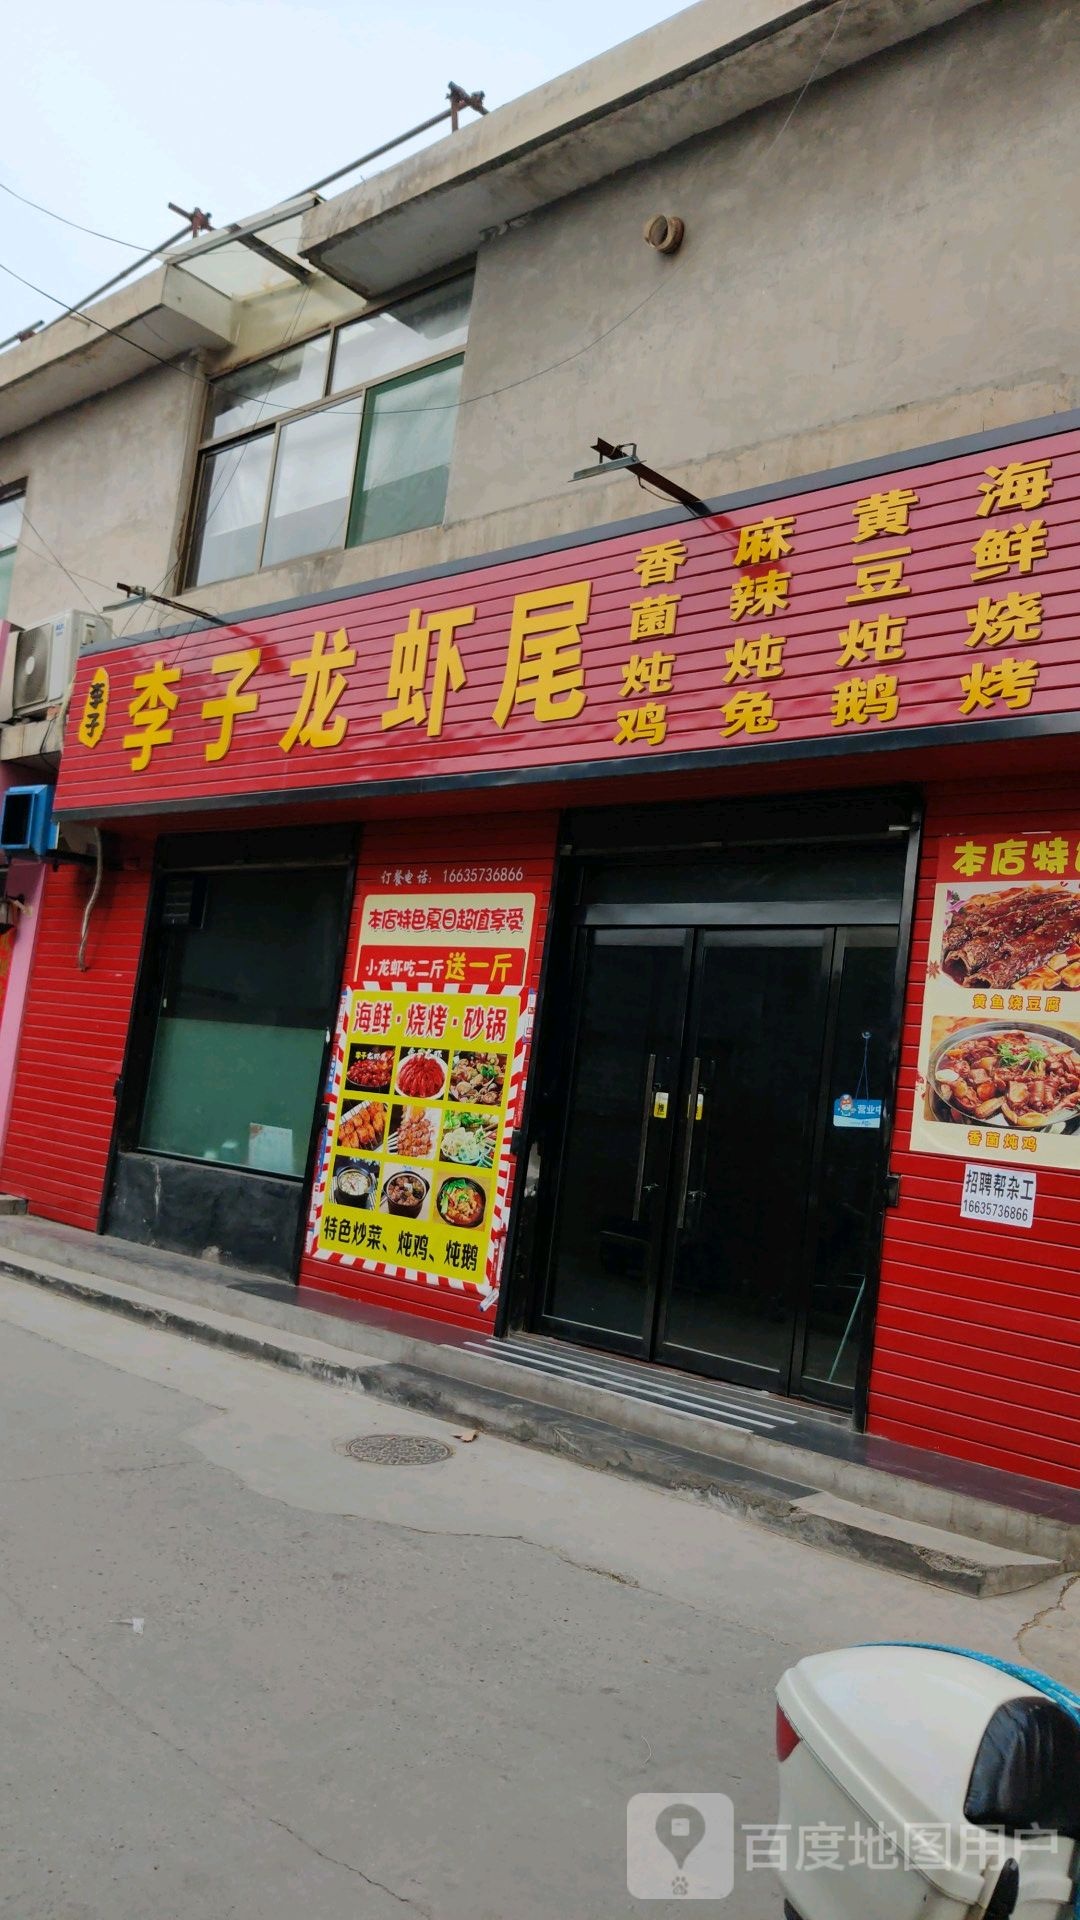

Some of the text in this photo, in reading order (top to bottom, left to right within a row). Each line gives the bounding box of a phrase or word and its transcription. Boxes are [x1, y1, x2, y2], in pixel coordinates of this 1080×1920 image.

[958, 459, 1054, 714] 海鲜烧烤
[720, 516, 795, 737] 麻辣炖兔
[831, 489, 919, 726] 黄豆炖鹅
[613, 539, 687, 745] 香菌炖鸡
[123, 580, 592, 771] 李子龙虾尾
[85, 683, 105, 737] 李子
[443, 867, 523, 883] 16635736866
[952, 837, 1080, 877] 本店特
[368, 907, 524, 932] 本店特色夏日超值享受
[365, 952, 513, 982] 小龙虾吃二斤送一斤
[972, 993, 1061, 1012] 黄鱼烧豆腐
[968, 1130, 1037, 1152] 香菌炖鸡
[965, 1170, 1034, 1200] 招聘帮杂工
[963, 1199, 1029, 1221] 16635736866
[324, 1215, 479, 1271] 特色炒菜、炖鸡、炖鹅
